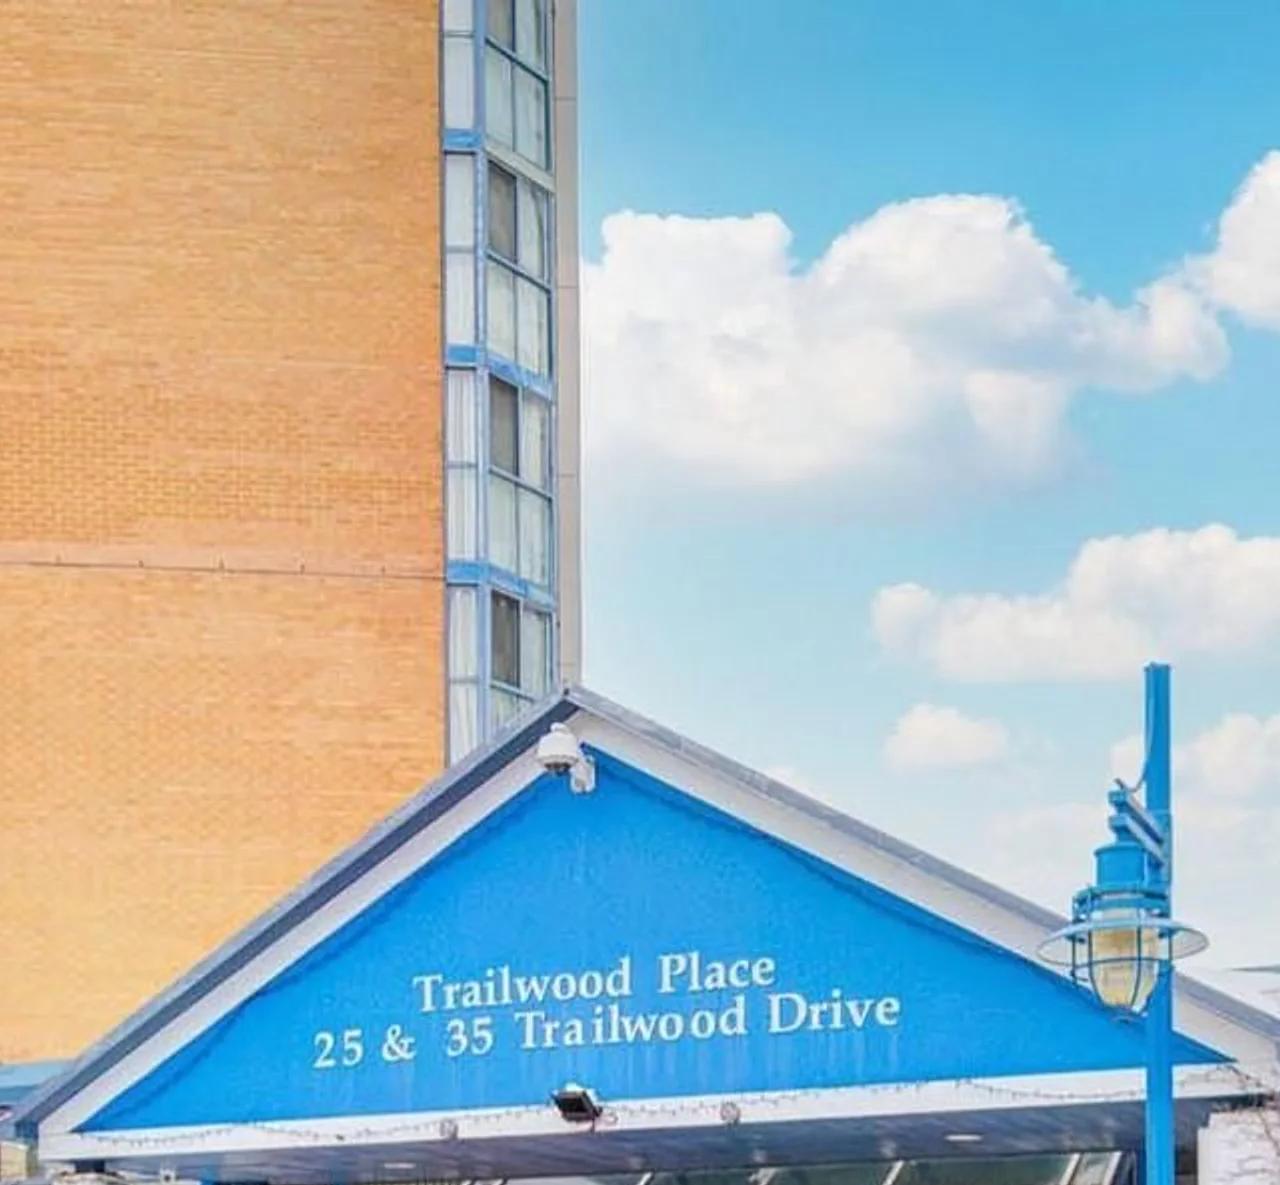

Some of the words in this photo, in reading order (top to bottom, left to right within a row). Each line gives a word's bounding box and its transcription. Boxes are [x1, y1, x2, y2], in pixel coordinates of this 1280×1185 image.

[413, 956, 632, 1012] Trailwood
[658, 951, 775, 993] Place
[313, 1029, 363, 1068] 25
[381, 1023, 416, 1061] &
[446, 1017, 493, 1057] 35
[515, 997, 748, 1049] Trailwood
[768, 989, 901, 1033] Drive
